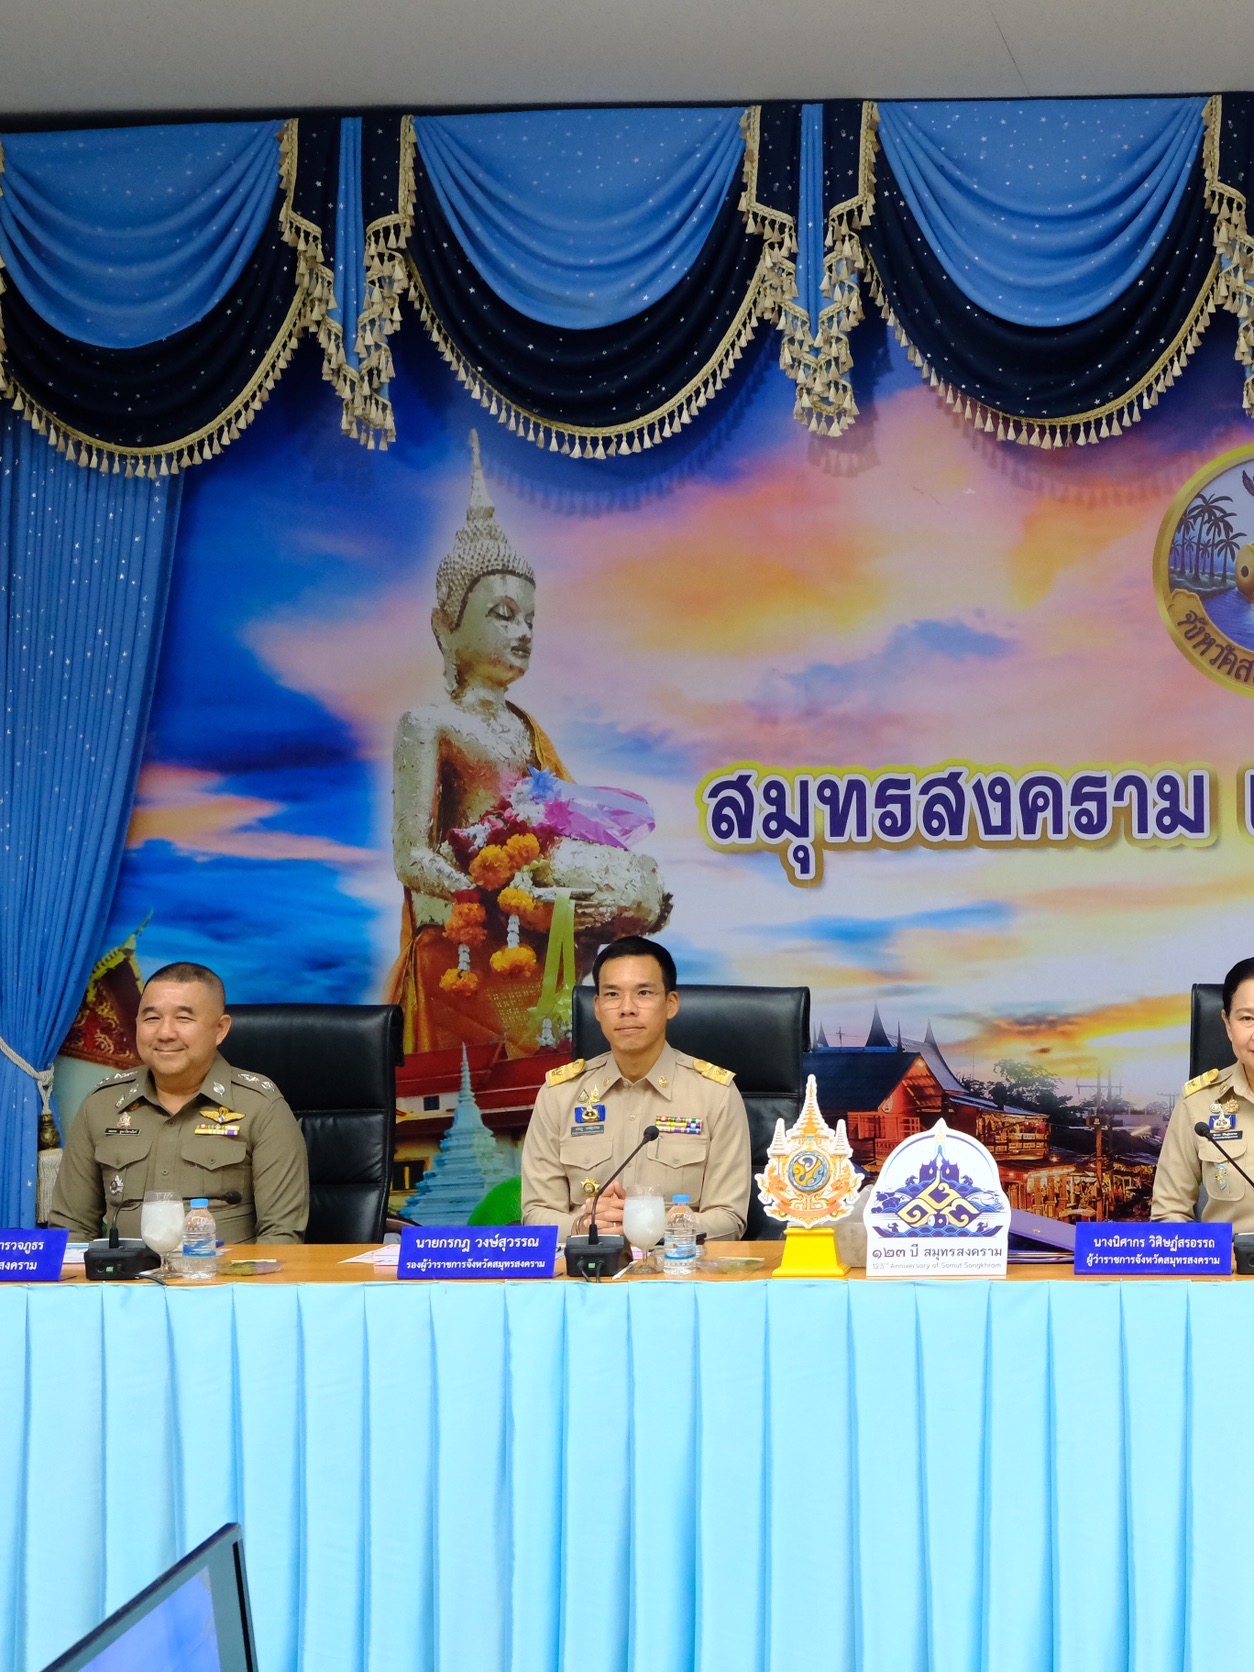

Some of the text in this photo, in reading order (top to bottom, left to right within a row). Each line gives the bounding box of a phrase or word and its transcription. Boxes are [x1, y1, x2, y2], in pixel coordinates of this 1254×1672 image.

[707, 771, 1205, 875] สมุทรสงคราม
[475, 1233, 539, 1252] วงษ์สุวรรณ
[1093, 1235, 1145, 1248] นางนิศากร
[872, 1243, 1002, 1260] ๑๒๓ ปี สมุทรสงคราม
[406, 1258, 546, 1272] รองผู้ว่าราชการจังหวัดสมุทรสงคราม
[890, 1262, 929, 1270] Anniversary
[1086, 1253, 1220, 1267] ผู้ว่าราชการจังหวัดสมุทรสงคราม
